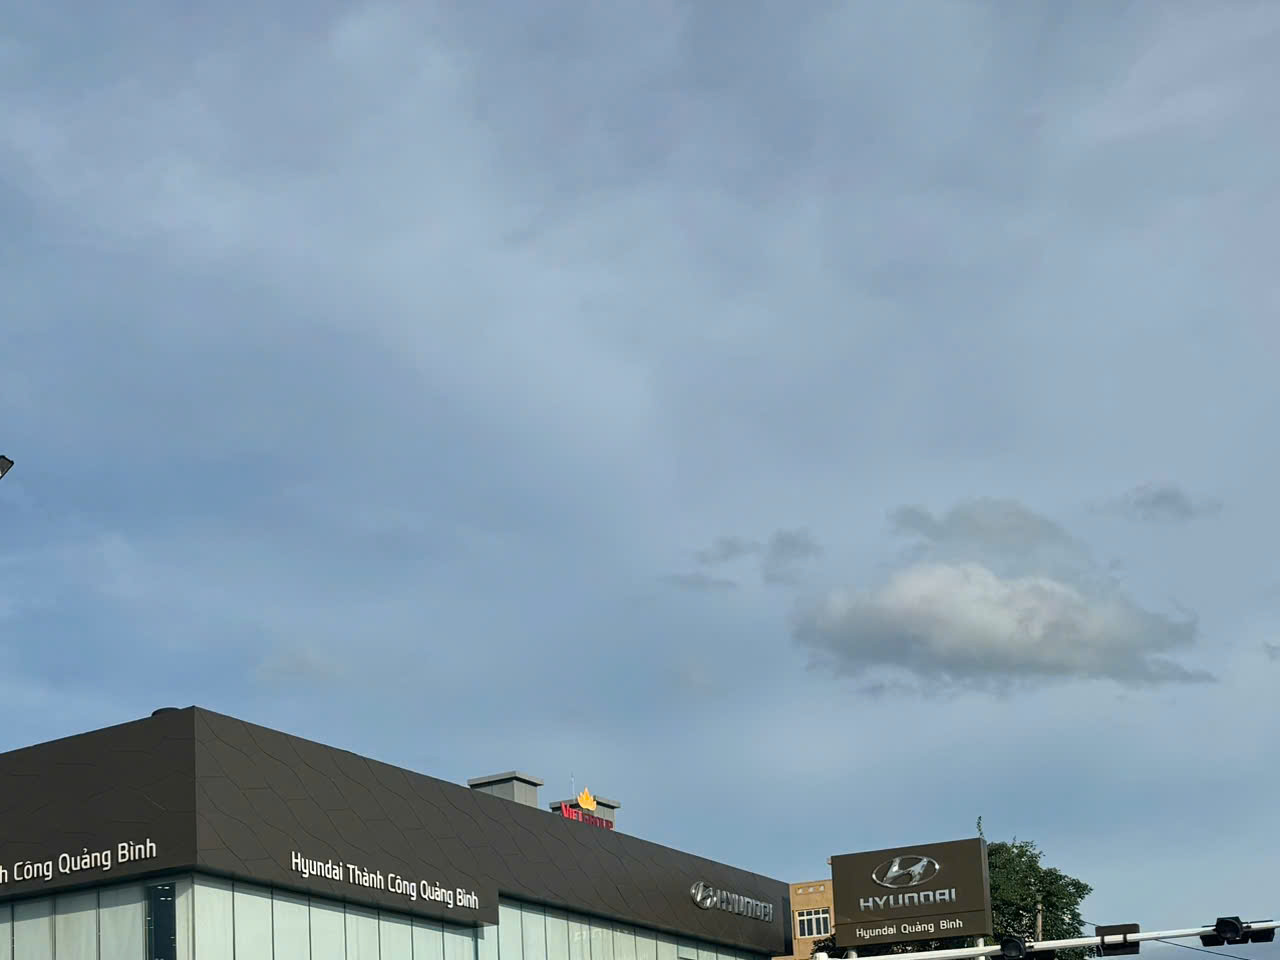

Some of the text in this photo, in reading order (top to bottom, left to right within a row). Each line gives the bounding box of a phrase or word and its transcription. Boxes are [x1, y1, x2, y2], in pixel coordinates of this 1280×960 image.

[14, 860, 52, 881] Công
[58, 848, 111, 873] Quảng
[118, 838, 156, 863] Bình
[291, 851, 480, 910] Hyundai Thành Công Quảng Bình
[716, 889, 774, 922] HYUNDAI
[859, 888, 957, 911] HYUNDAI
[856, 925, 897, 939] Hyundai
[940, 918, 963, 930] Bình
